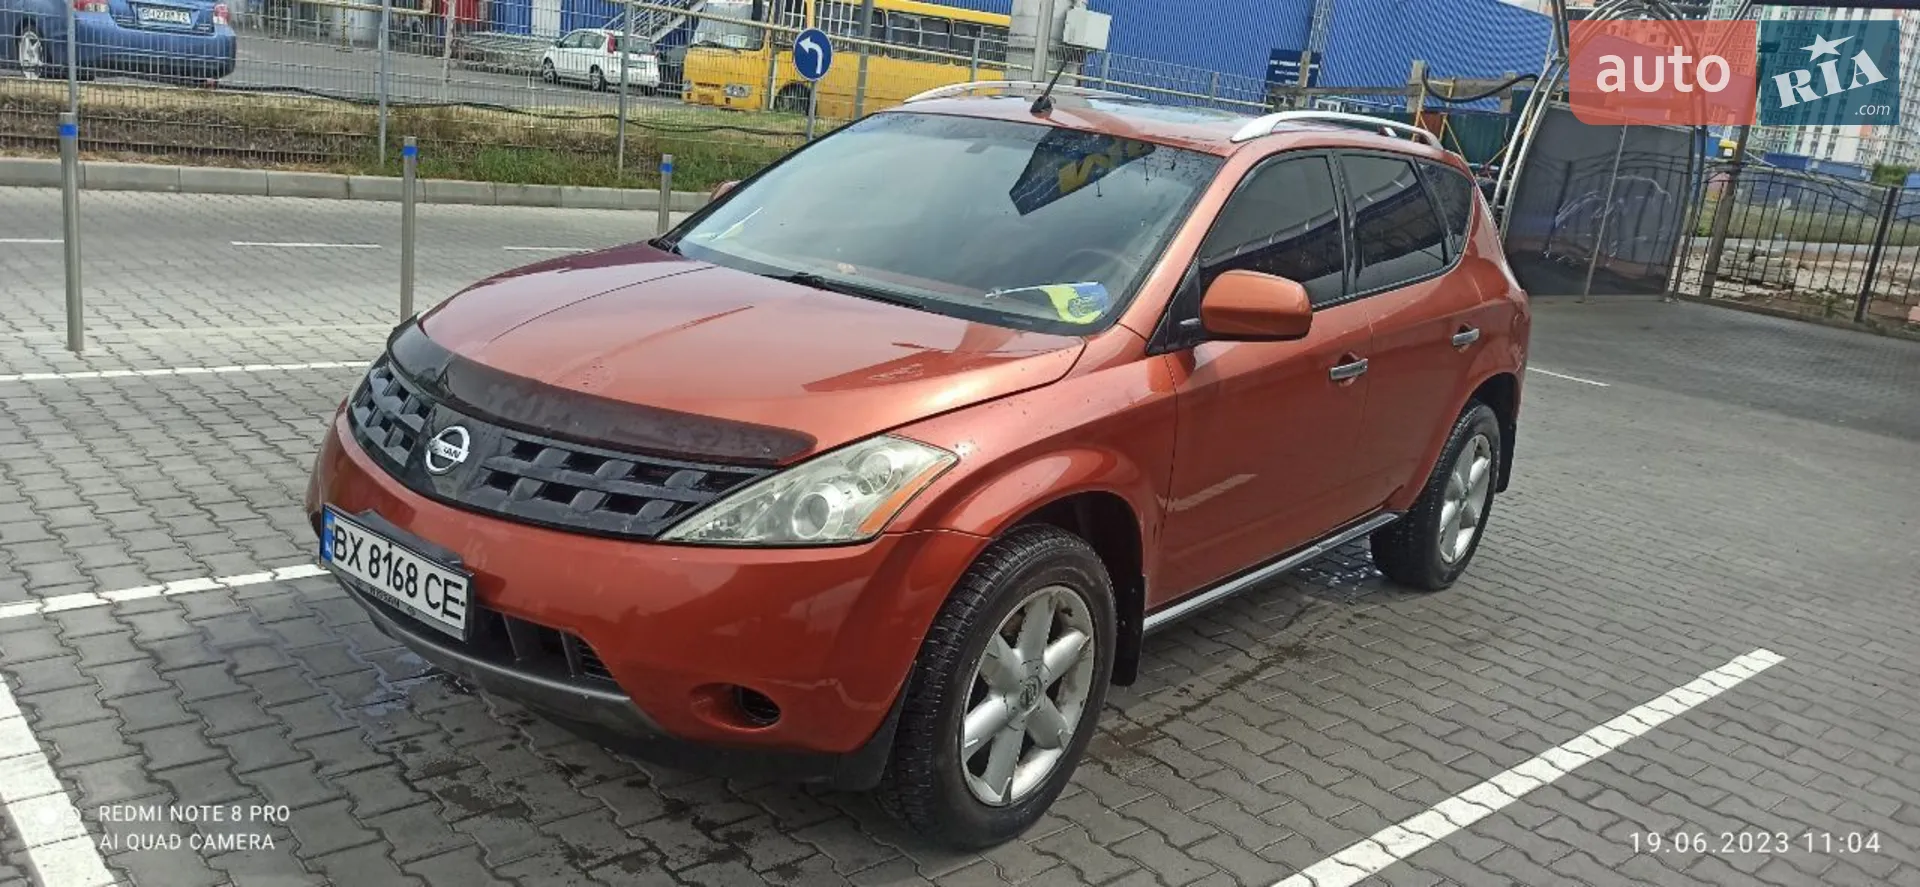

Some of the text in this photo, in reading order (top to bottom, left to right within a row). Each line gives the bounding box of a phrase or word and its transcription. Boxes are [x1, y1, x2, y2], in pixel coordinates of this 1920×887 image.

[334, 523, 364, 572] BX
[368, 543, 418, 599] 8168
[425, 573, 463, 621] CE
